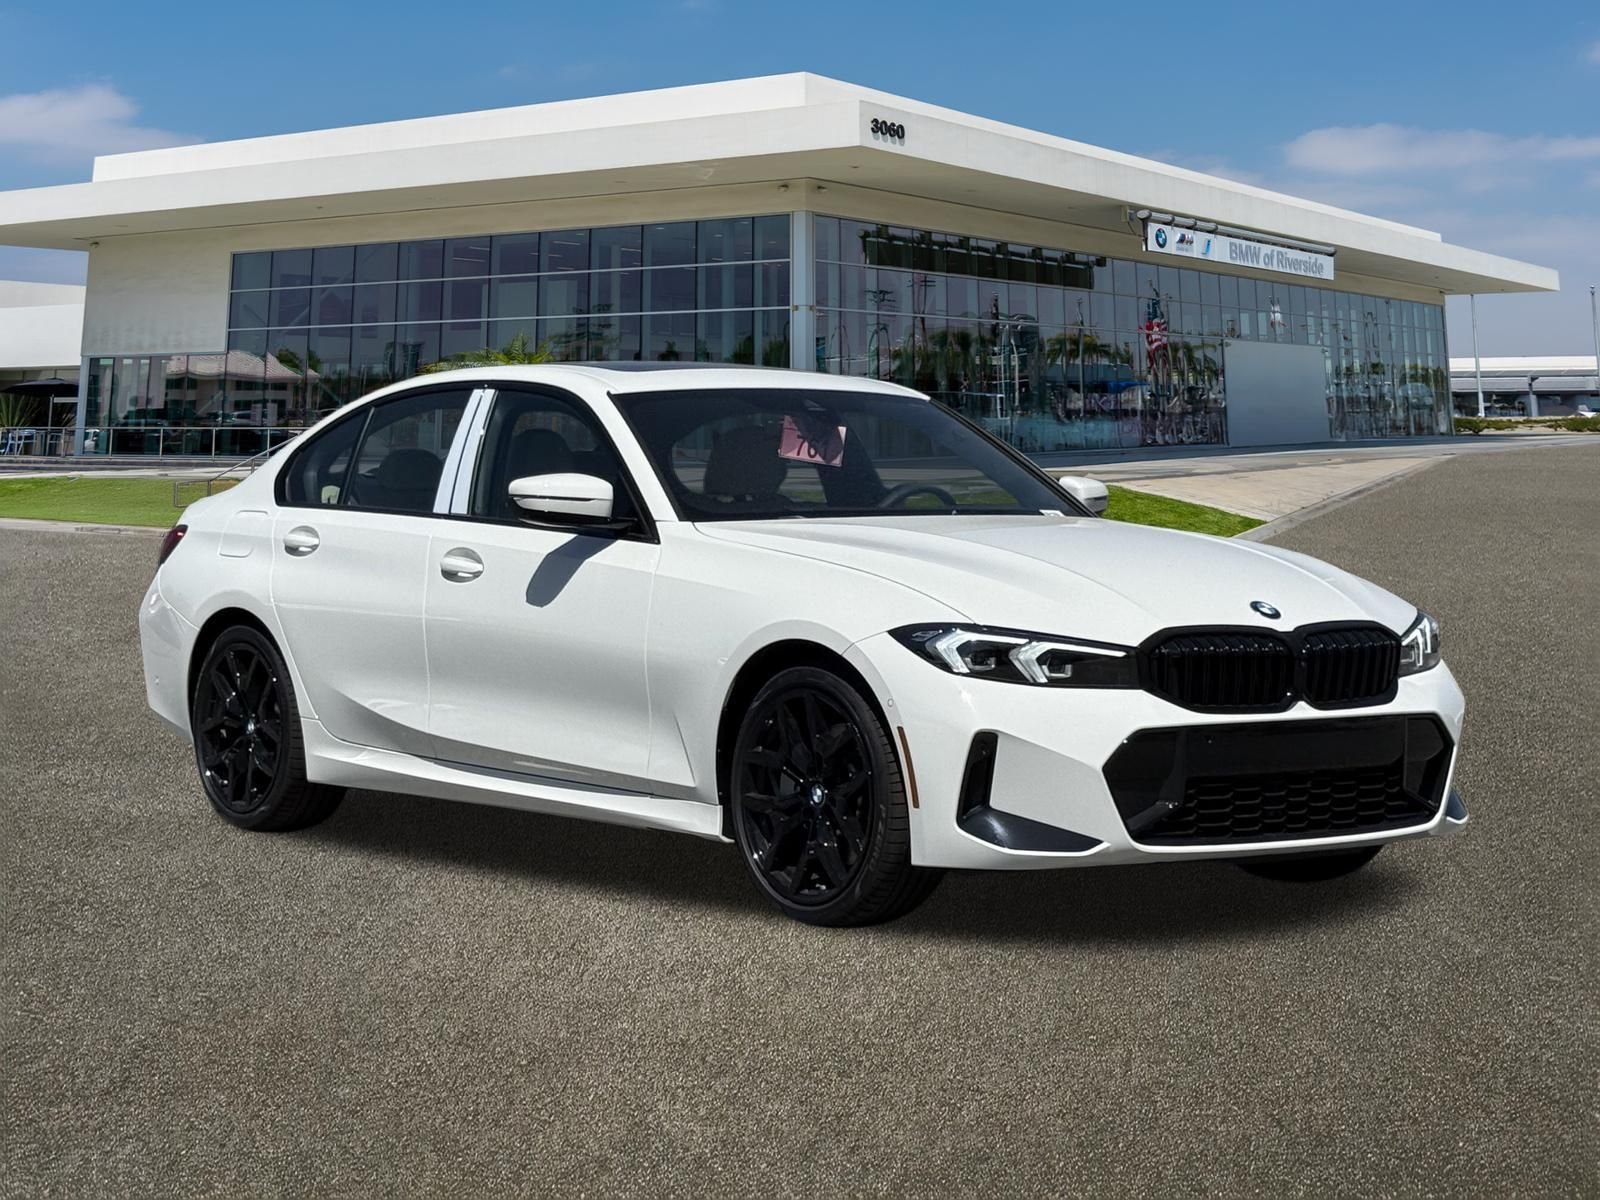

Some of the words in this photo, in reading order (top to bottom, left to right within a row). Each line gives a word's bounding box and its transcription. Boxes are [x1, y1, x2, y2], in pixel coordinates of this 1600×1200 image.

[870, 117, 906, 140] 3060
[1229, 241, 1261, 266] BMW
[1263, 249, 1275, 268] of
[1276, 250, 1324, 274] Riverside
